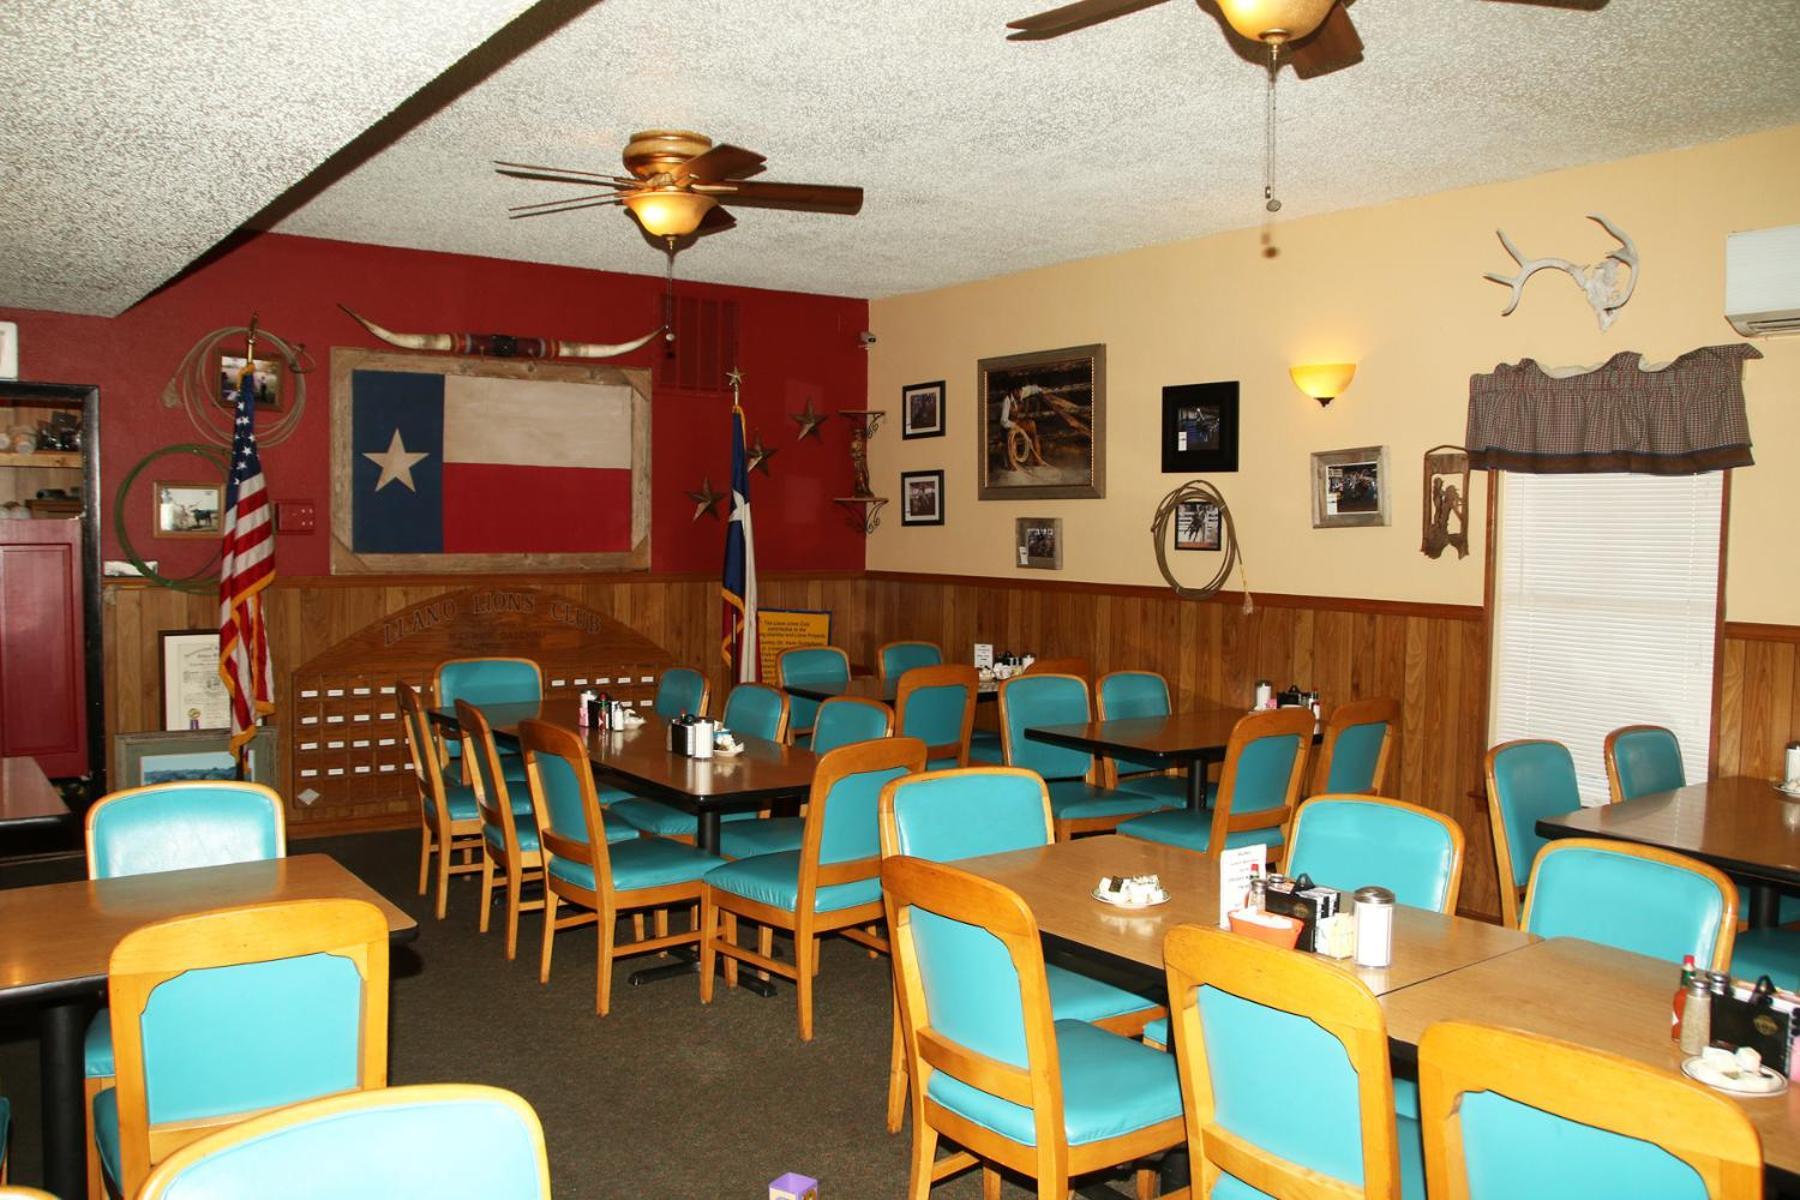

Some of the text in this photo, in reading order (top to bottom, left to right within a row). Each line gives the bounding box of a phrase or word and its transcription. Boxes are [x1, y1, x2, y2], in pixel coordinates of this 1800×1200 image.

[384, 591, 602, 648] LLANO LIONS CLUB
